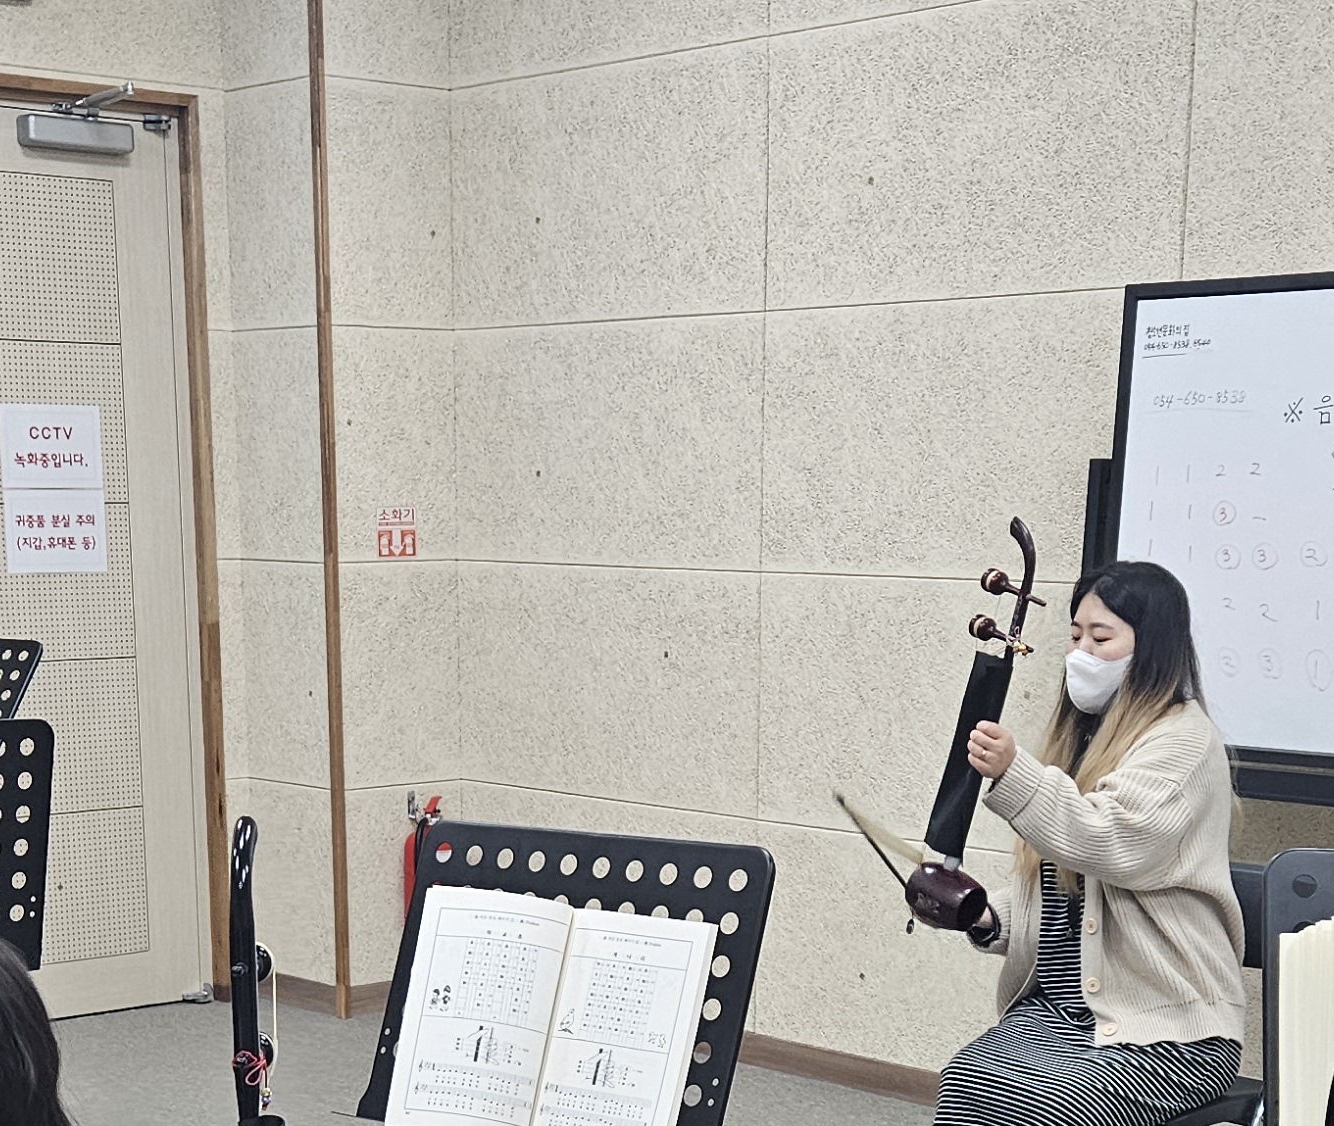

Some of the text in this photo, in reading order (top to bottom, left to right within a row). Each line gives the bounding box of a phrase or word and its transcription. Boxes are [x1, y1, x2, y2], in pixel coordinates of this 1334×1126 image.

[1153, 389, 1246, 409] 054-650-8538
[29, 426, 73, 440] CCTV
[14, 452, 89, 468] 녹화중입니다.
[16, 514, 95, 529] 귀중품 분실 주의
[378, 508, 415, 521] 소화기
[16, 535, 96, 551] (지갑,휴대폰 등)
